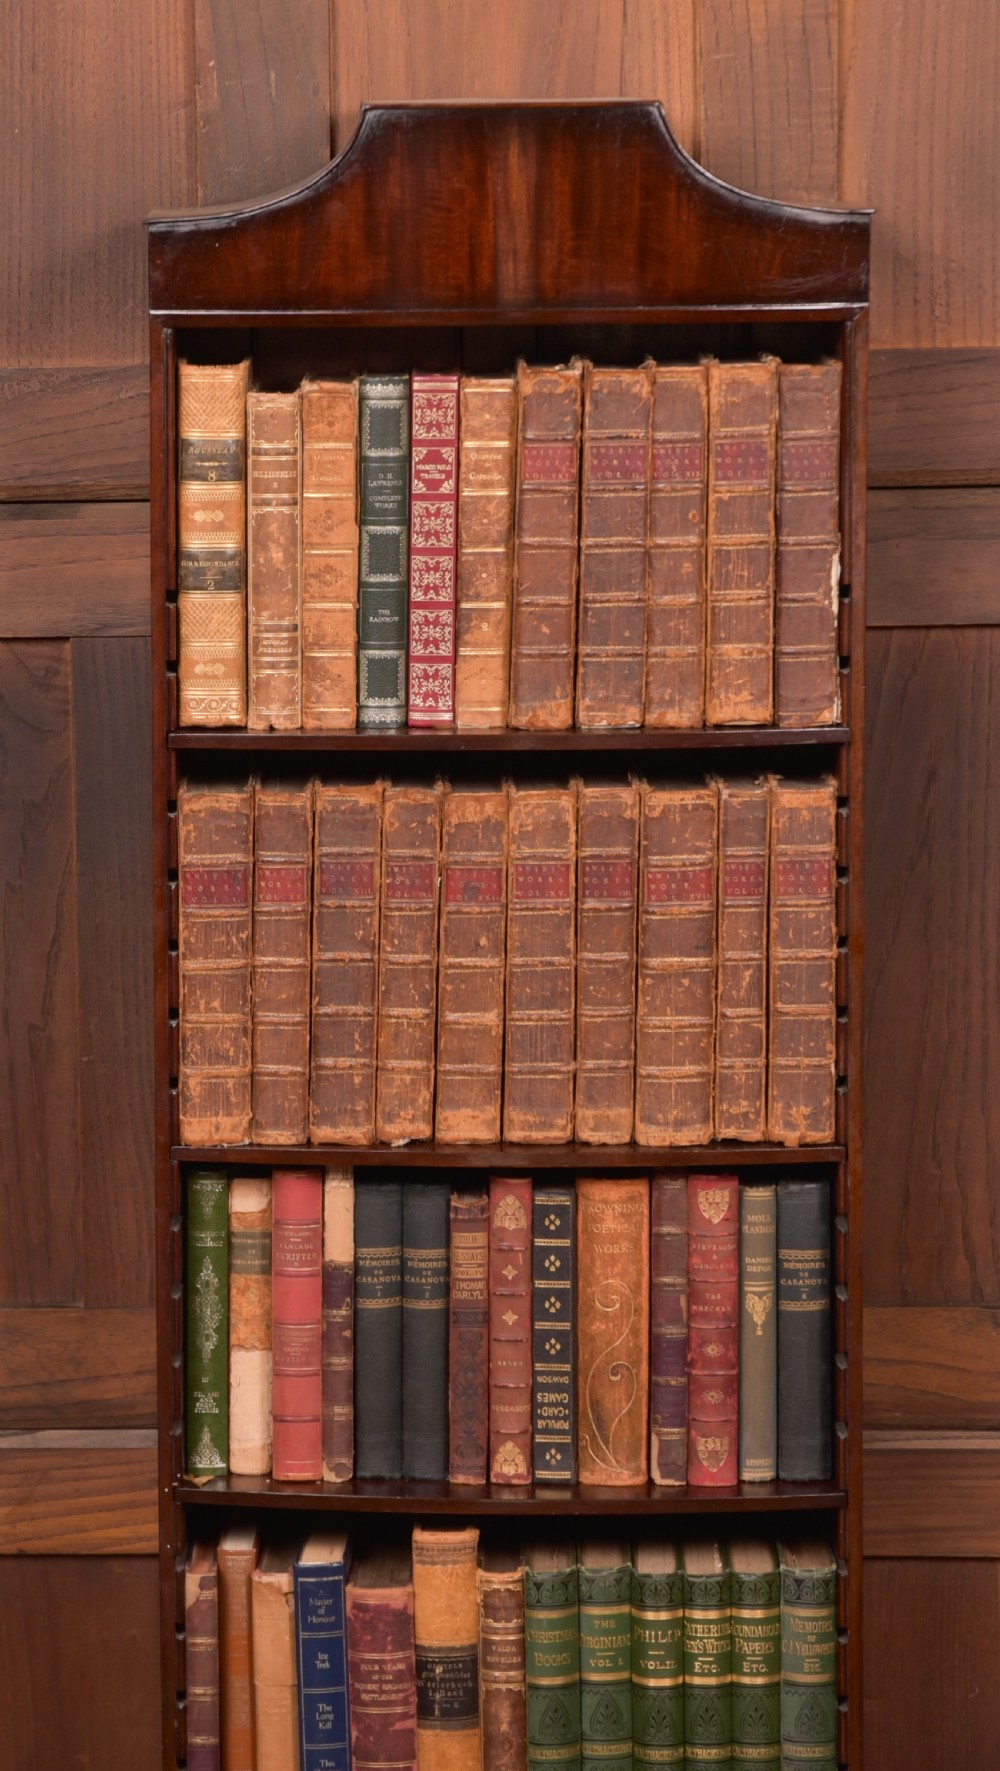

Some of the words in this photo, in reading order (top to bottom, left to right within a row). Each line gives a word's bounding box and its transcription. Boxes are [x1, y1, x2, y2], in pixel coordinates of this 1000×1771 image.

[188, 446, 236, 454] ROUSSEAU
[207, 470, 217, 482] 8
[207, 579, 215, 590] 2
[368, 616, 400, 624] RAINBOW
[746, 1214, 772, 1222] MOLL
[358, 1257, 400, 1267] MÉMOIRES
[407, 1258, 448, 1268] MÉMOIRES
[745, 1256, 774, 1264] DANIEL
[783, 1260, 826, 1269] MÉMOIRES
[356, 1275, 401, 1283] CASANOVA
[405, 1276, 450, 1284] CASANOVA
[455, 1281, 487, 1290] THOMAS
[453, 1290, 488, 1299] CARLYLE
[536, 1375, 569, 1383] DAWSON
[536, 1392, 569, 1403] GAMES
[541, 1406, 565, 1416] CARD
[537, 1420, 570, 1430] POPULAR
[309, 1598, 334, 1606] Master
[317, 1606, 326, 1615] of
[307, 1615, 336, 1624] Honour
[593, 1620, 616, 1629] THE
[731, 1621, 780, 1637] OUNDABOUT
[790, 1617, 834, 1633] MEMOIRS
[527, 1627, 578, 1643] CHRISTMAS
[634, 1625, 681, 1643] PHILIP
[735, 1638, 774, 1654] PAPERS
[318, 1651, 329, 1660] Ice
[534, 1652, 571, 1666] BOOKS
[315, 1660, 331, 1669] Trek
[317, 1703, 333, 1712] The
[315, 1712, 335, 1721] Long
[318, 1721, 332, 1730] Kill
[319, 1759, 336, 1768] This
